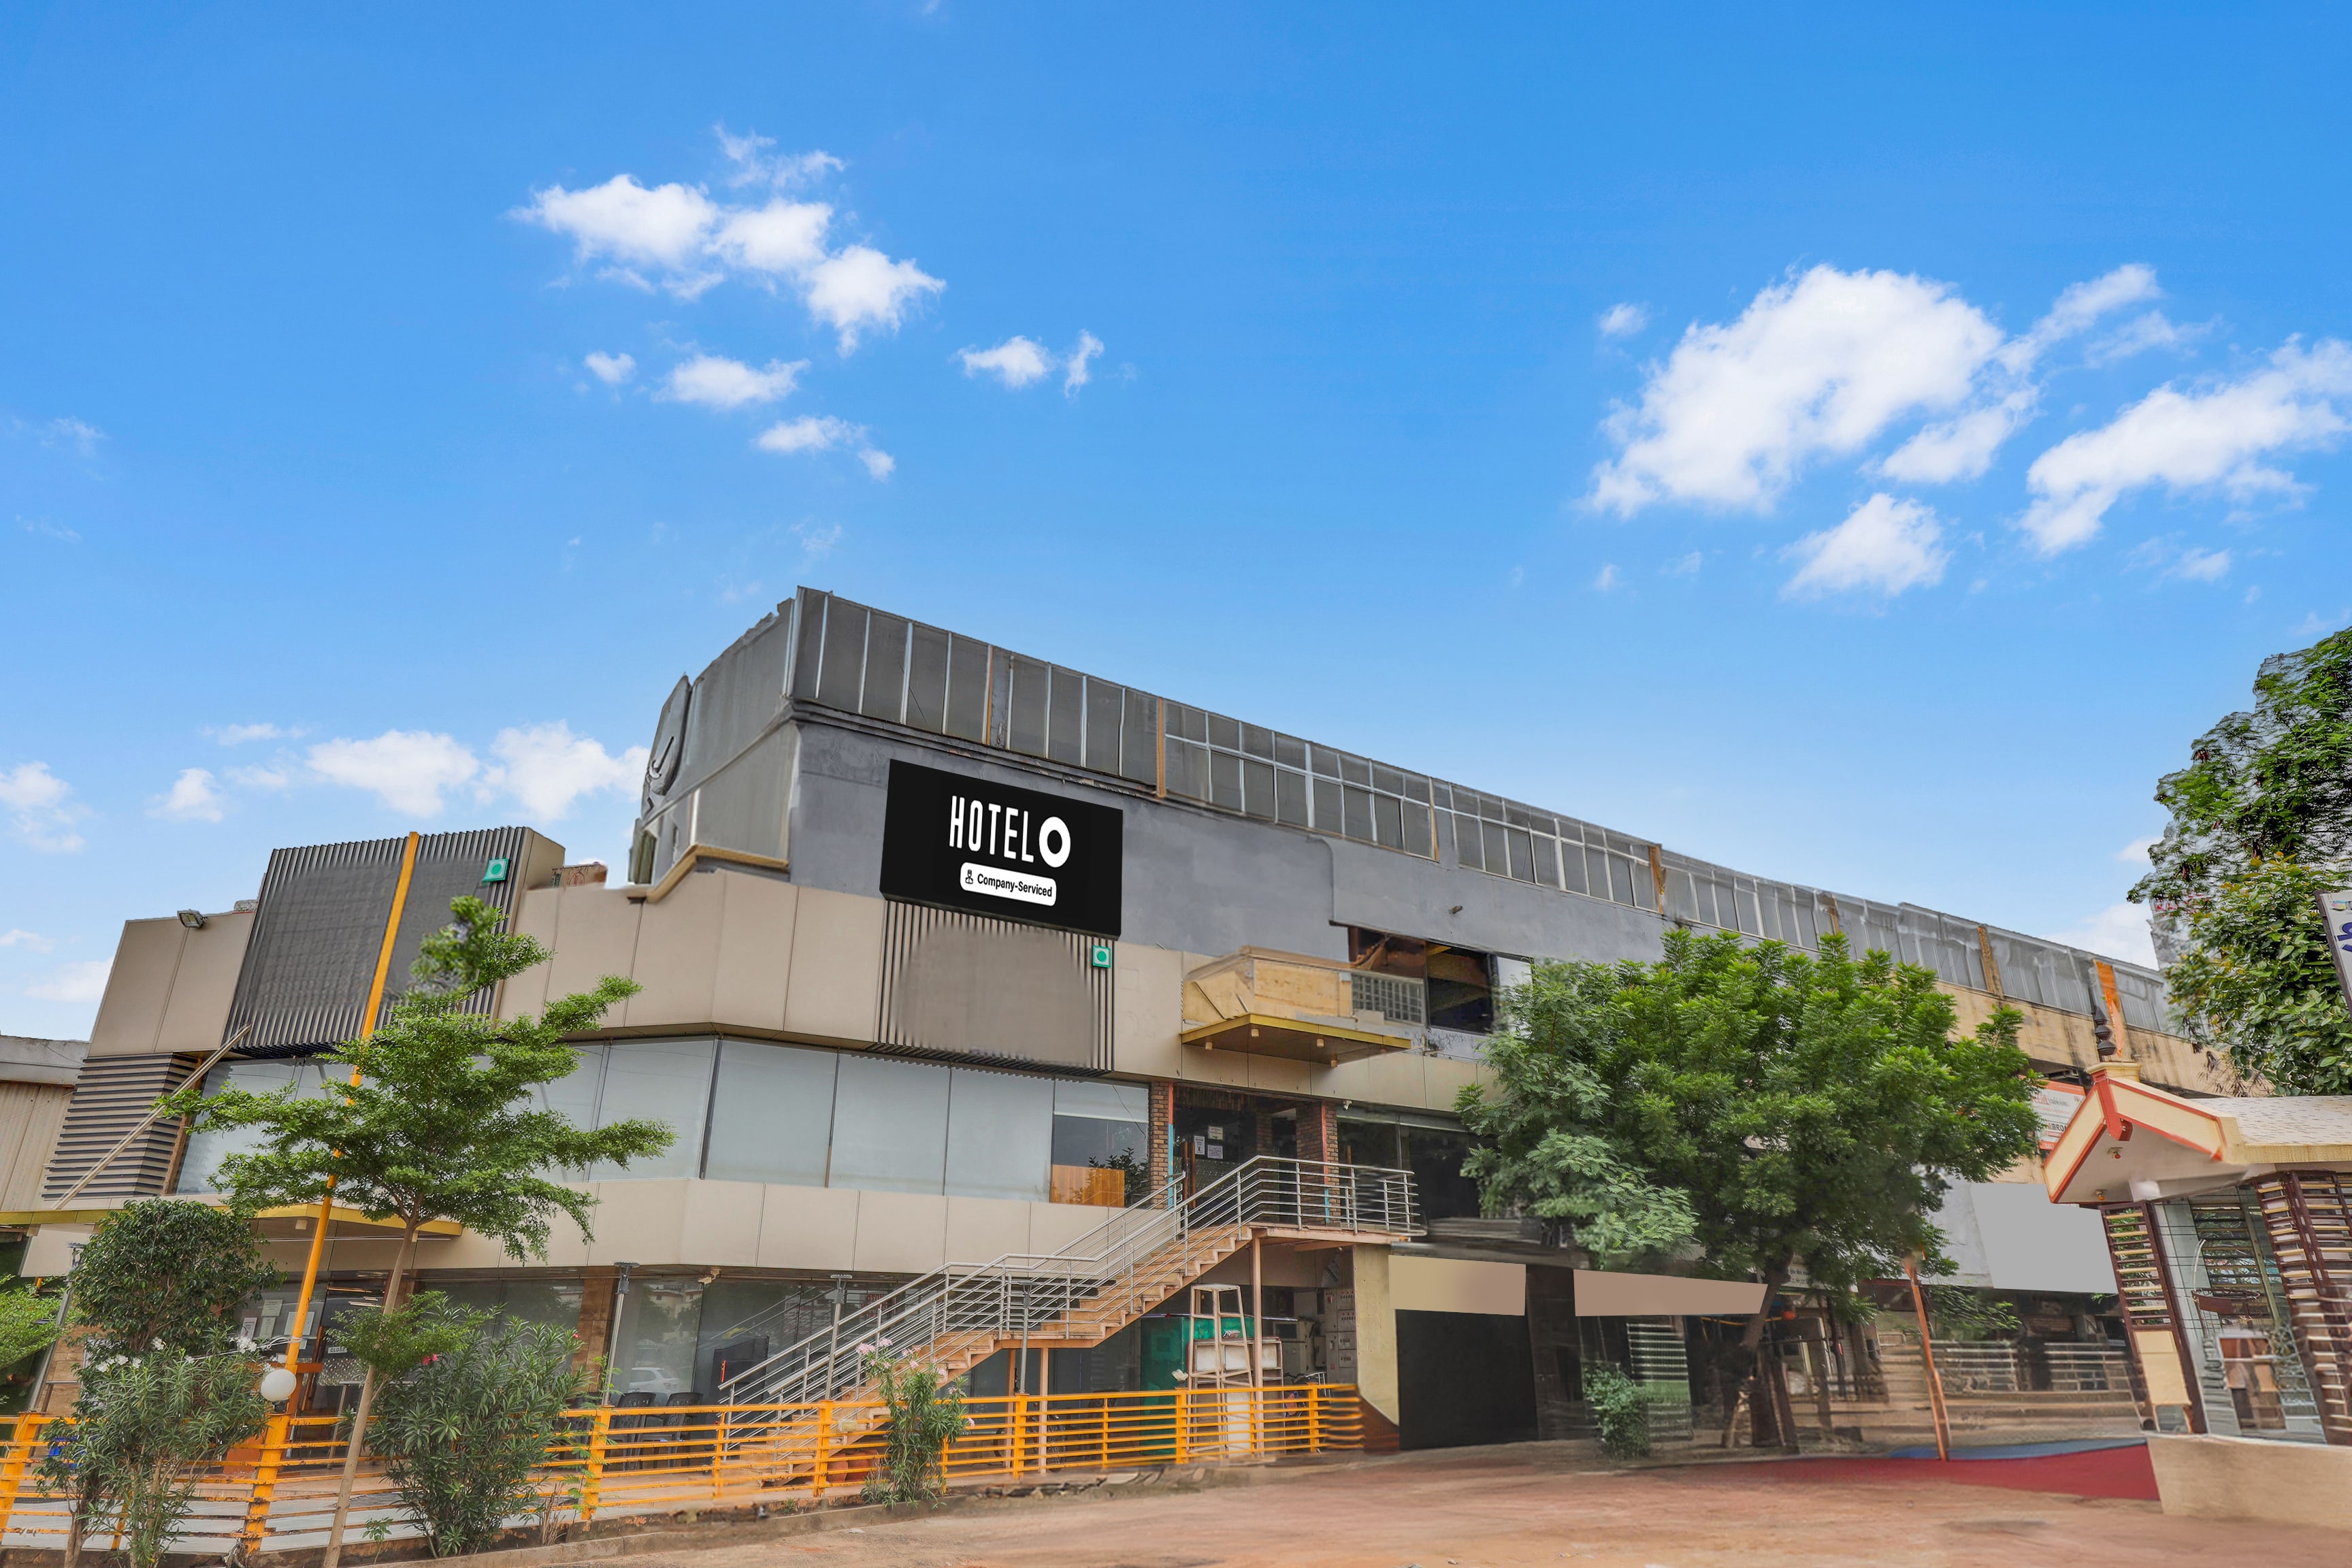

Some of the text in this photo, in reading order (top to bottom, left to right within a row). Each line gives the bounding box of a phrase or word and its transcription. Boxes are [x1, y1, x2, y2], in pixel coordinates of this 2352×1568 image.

[949, 795, 1071, 868] HOTEL O
[977, 873, 1052, 897] Company-Serviced
